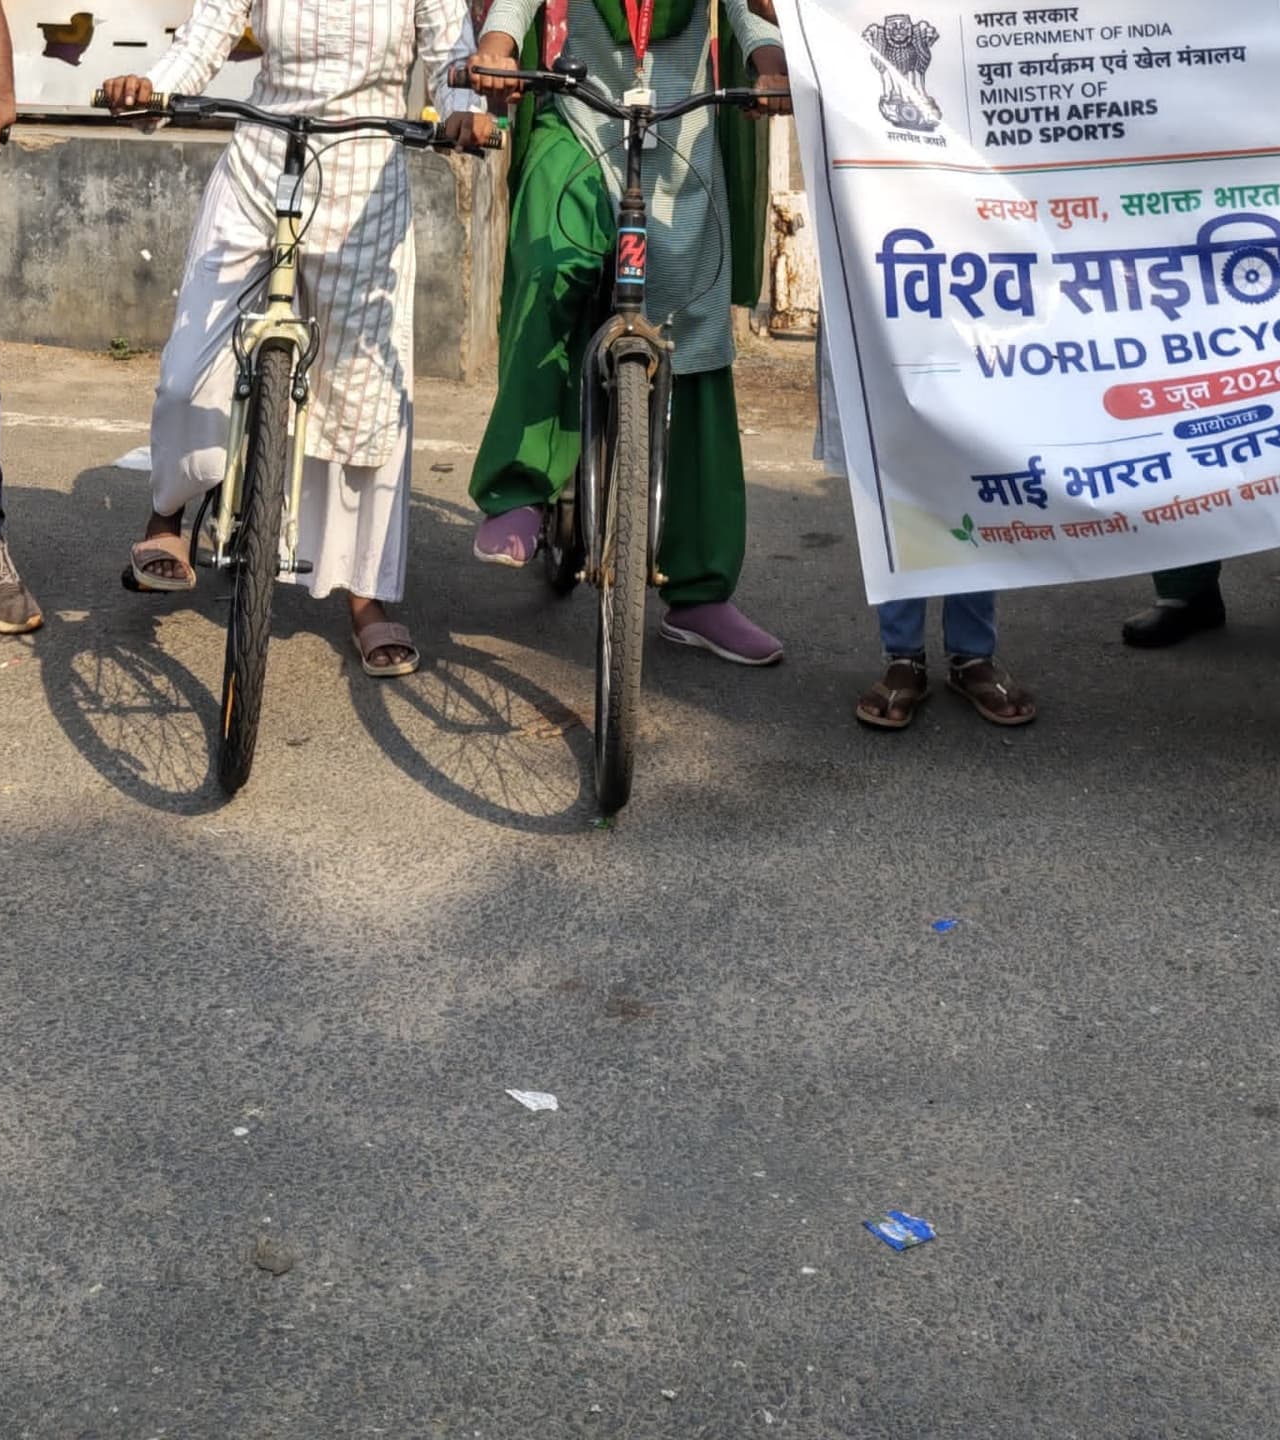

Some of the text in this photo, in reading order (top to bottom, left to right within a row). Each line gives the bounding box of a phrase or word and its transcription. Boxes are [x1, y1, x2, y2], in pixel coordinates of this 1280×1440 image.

[973, 6, 1079, 29] भारत सरकार
[975, 22, 1172, 50] GOVERNMENT OF INDIA
[977, 42, 1247, 87] युवा कार्यक्रम एवं खेल मंत्रालय
[979, 80, 1108, 106] MINISTRY OF
[981, 98, 1158, 127] YOUTH AFFAIRS
[985, 121, 1125, 148] AND SPORTS
[976, 183, 1280, 231] स्वस्थ युवा, सशक्त भारत
[876, 228, 1037, 321] विश्व
[975, 336, 1148, 380] WORLD
[1139, 388, 1157, 409] 3
[1165, 381, 1210, 412] जून
[1187, 407, 1260, 437] आयोजक
[971, 456, 1048, 509] माई
[1064, 451, 1173, 500] भारत
[978, 520, 1056, 545] साइकिल
[1060, 513, 1138, 541] चलाओ,
[1142, 493, 1232, 526] पर्यावरण
